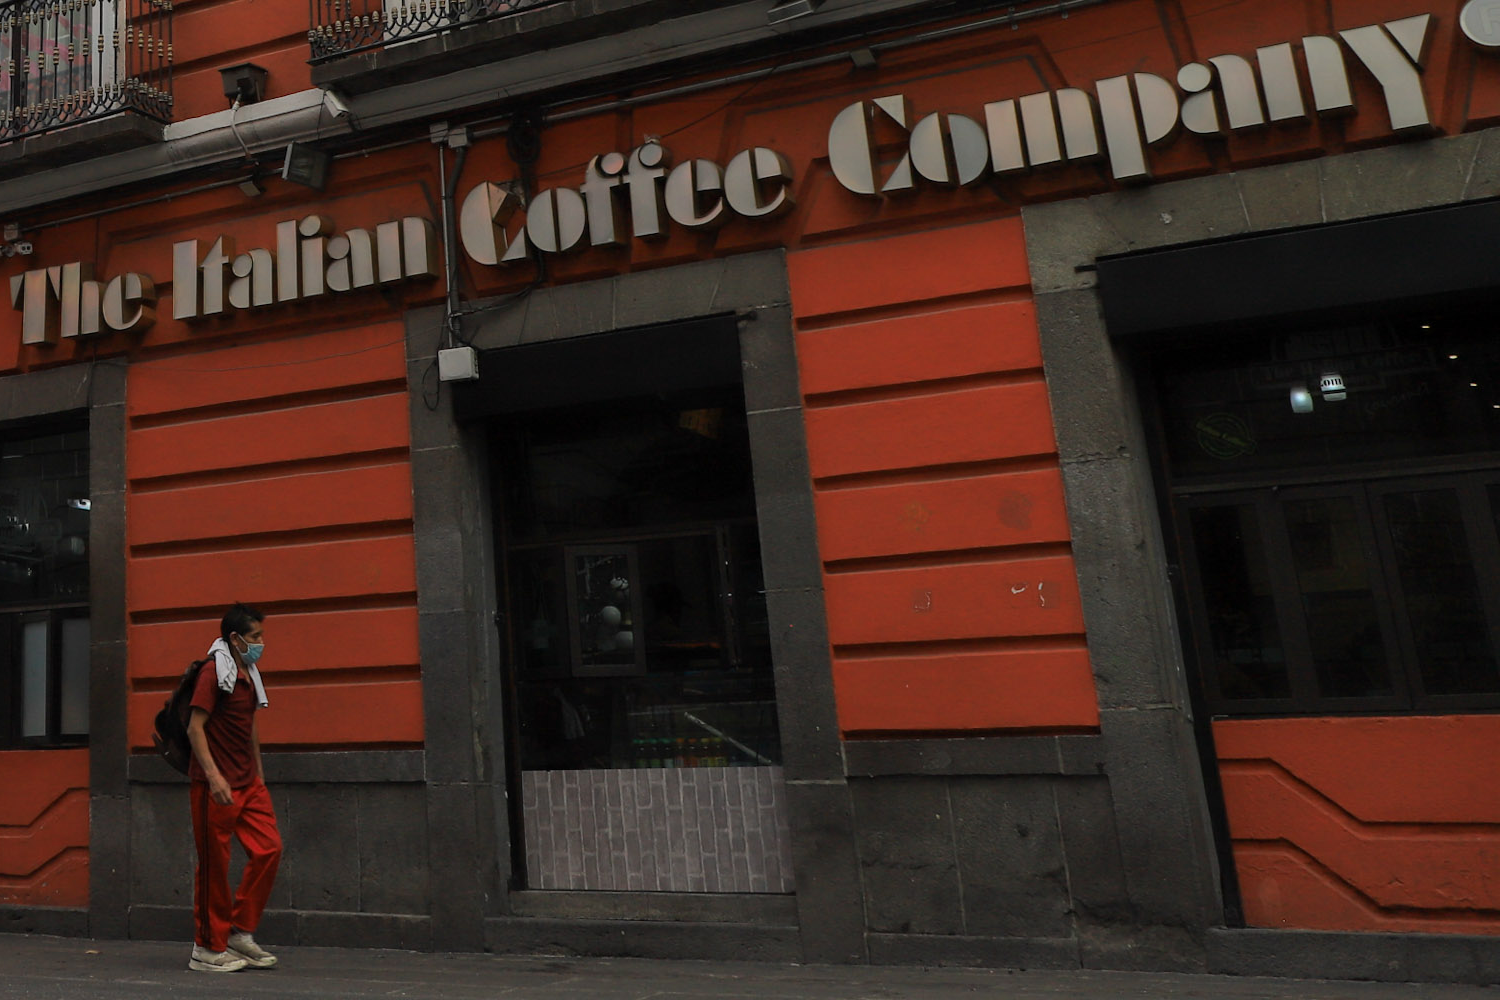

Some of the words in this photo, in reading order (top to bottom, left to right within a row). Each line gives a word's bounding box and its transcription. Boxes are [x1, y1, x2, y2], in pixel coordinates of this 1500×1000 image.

[10, 261, 150, 345] The
[173, 213, 434, 321] Italian
[460, 142, 792, 266] Coffee
[828, 13, 1432, 195] Company
